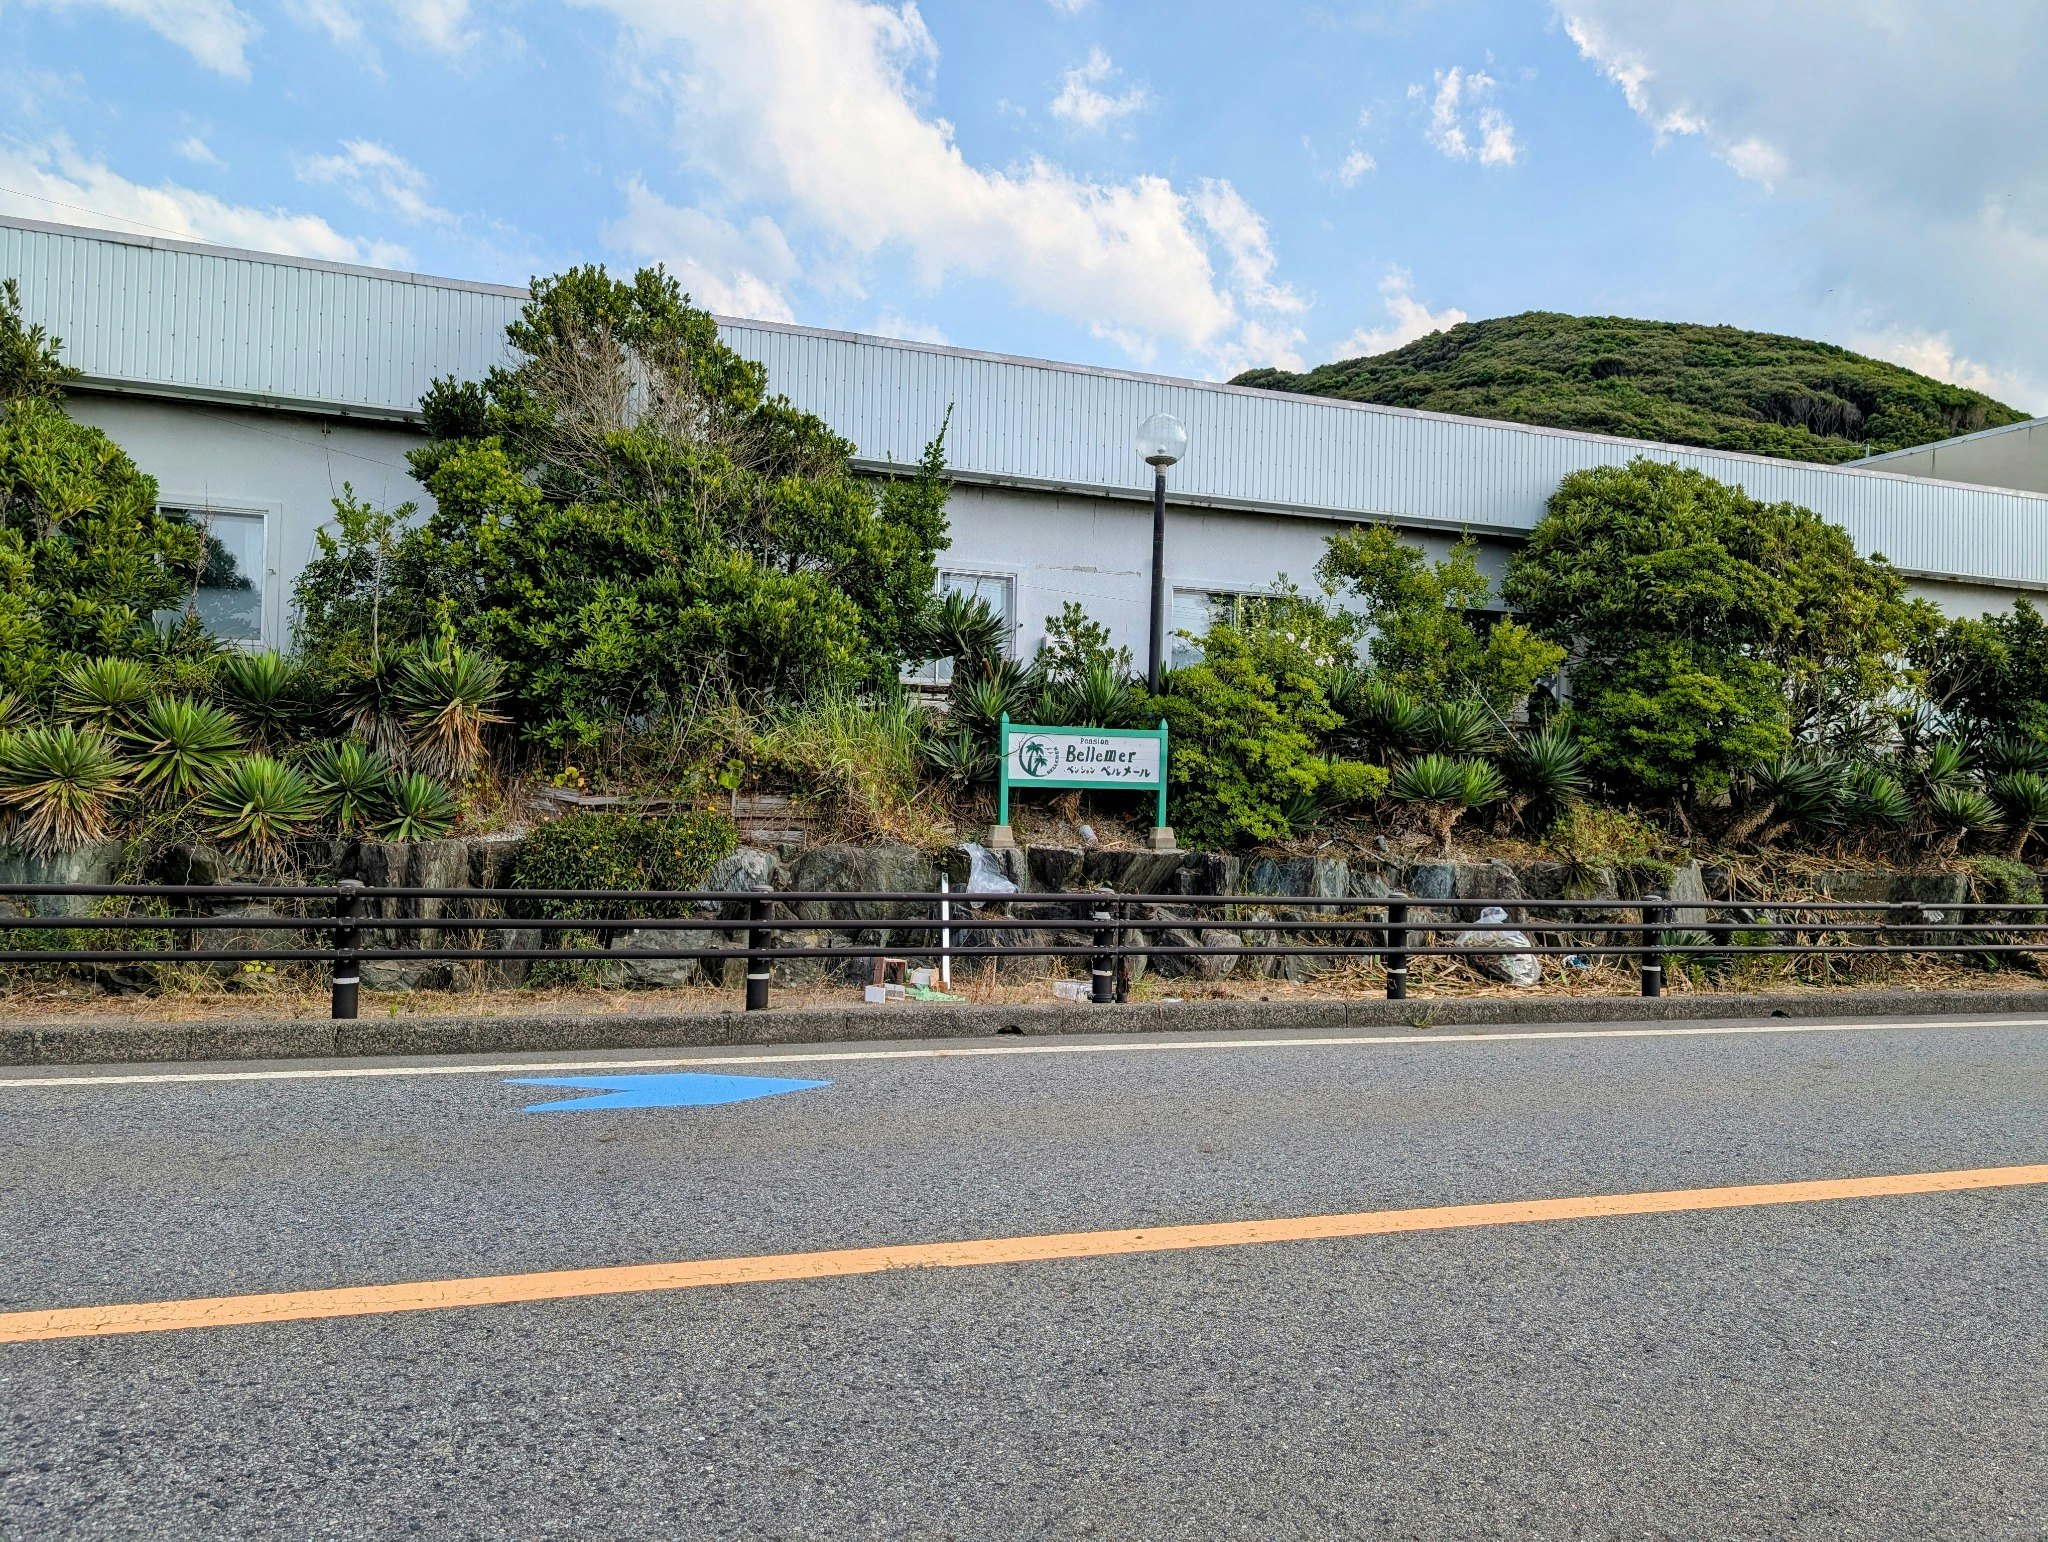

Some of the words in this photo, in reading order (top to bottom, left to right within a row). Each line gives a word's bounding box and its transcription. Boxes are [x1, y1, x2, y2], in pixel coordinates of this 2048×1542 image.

[1080, 737, 1109, 745] Pension
[1065, 745, 1137, 763] Bellemer
[1100, 765, 1151, 778] ベルメール
